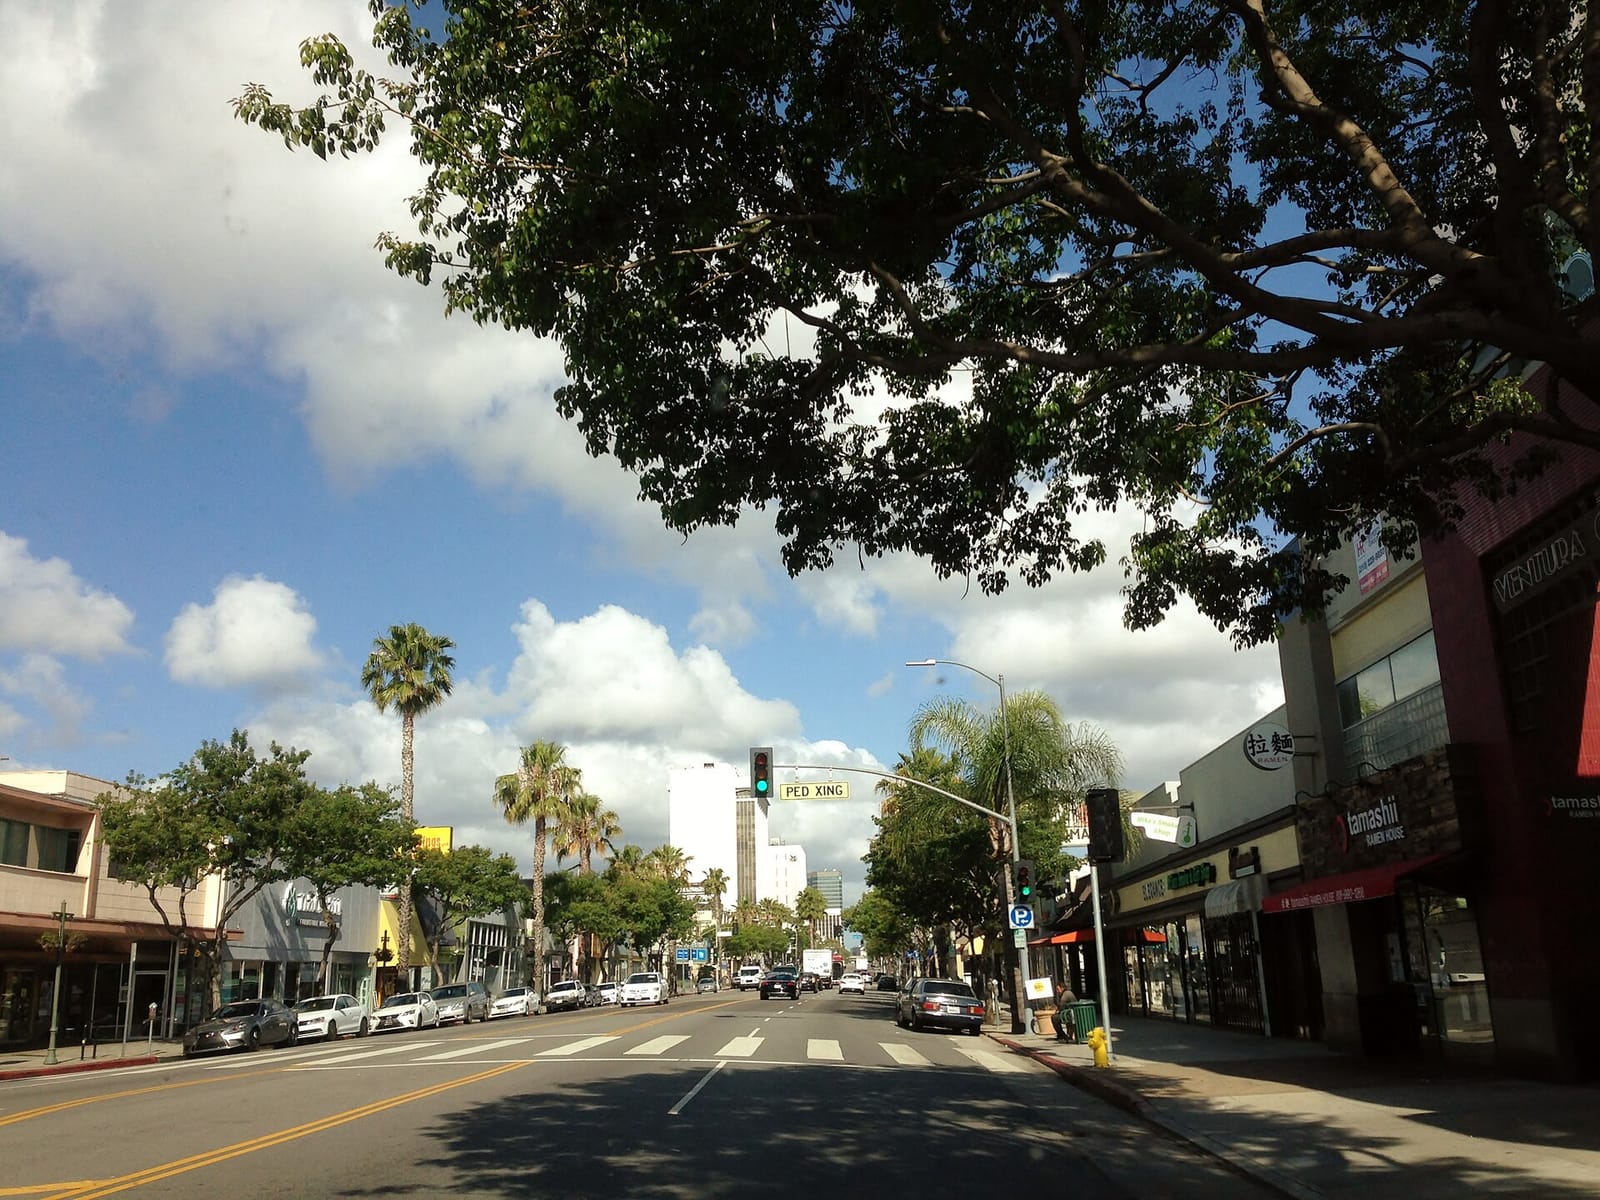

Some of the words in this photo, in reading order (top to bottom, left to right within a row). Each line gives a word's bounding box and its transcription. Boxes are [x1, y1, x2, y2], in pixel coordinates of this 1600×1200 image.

[1493, 530, 1586, 603] VENTURA
[1248, 731, 1294, 757] 拉麵
[786, 786, 810, 798] PED
[815, 784, 843, 797] XING
[1347, 795, 1399, 836] tamashii
